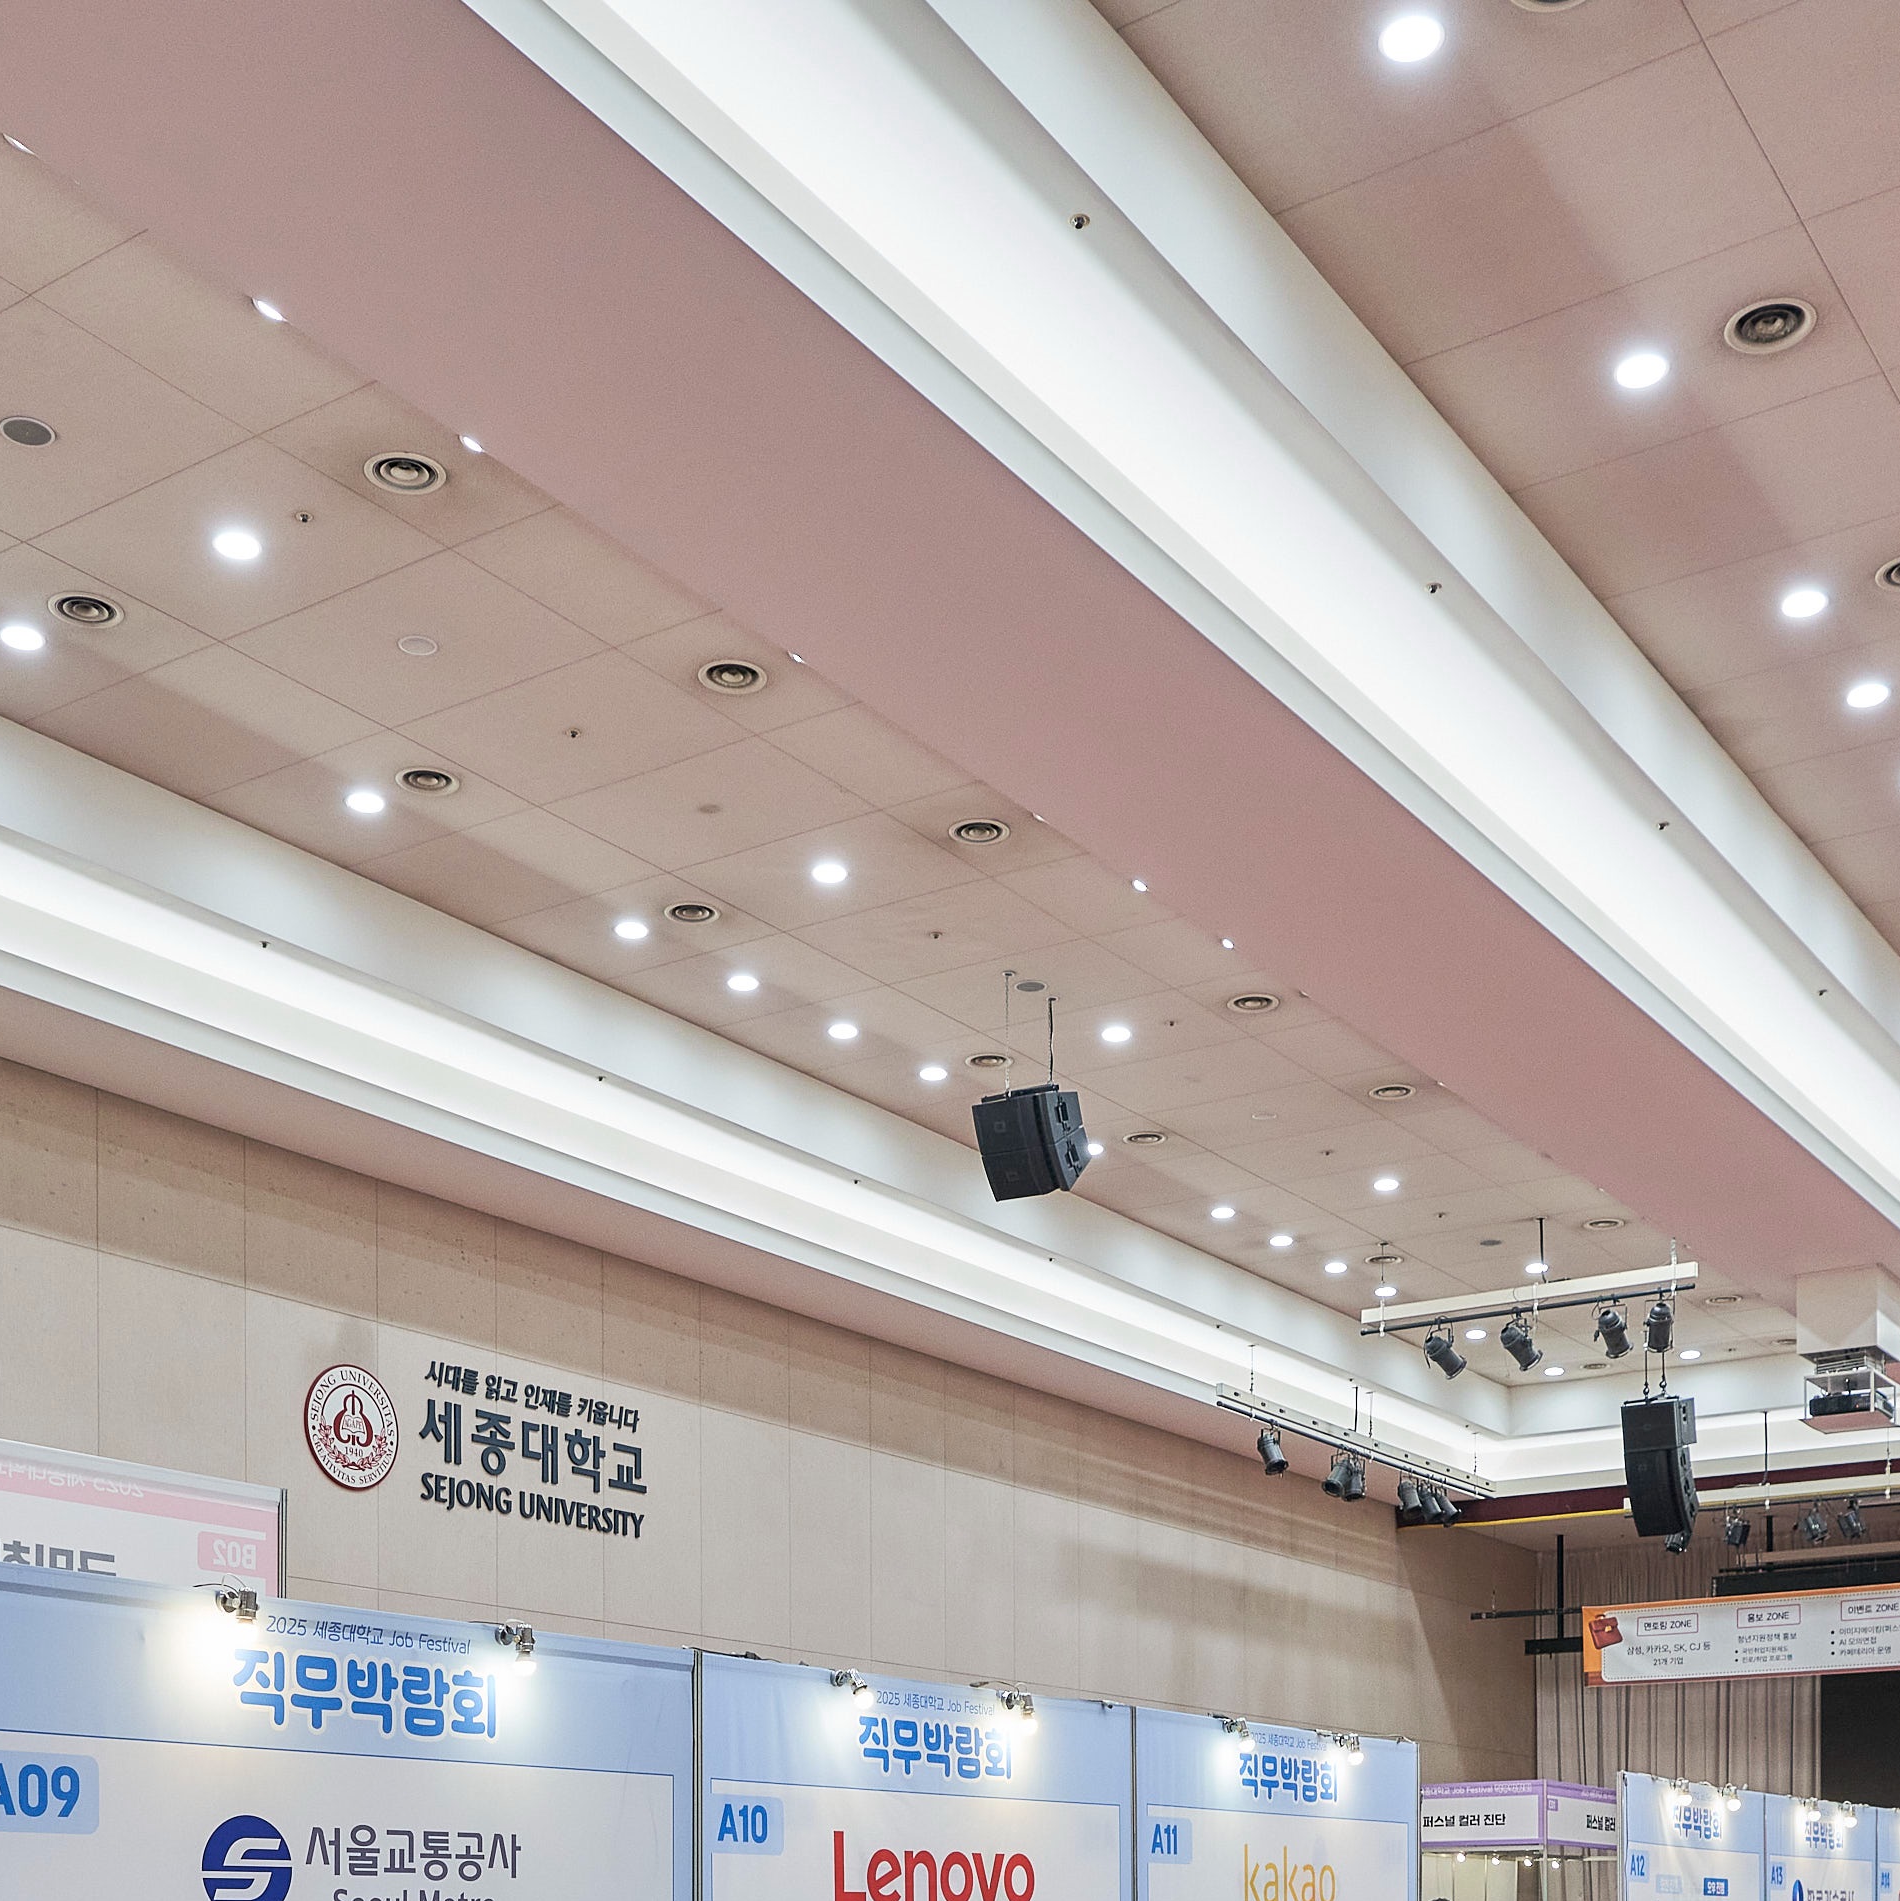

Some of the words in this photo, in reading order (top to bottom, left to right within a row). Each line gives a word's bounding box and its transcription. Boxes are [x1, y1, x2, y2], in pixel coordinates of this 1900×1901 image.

[310, 1374, 336, 1422] SEJONG
[340, 1370, 395, 1437] UNIVERSITAS
[424, 1361, 479, 1395] 시대를
[485, 1375, 518, 1403] 읽고
[524, 1384, 572, 1417] 인재를
[577, 1398, 640, 1433] 키웁니다
[311, 1433, 356, 1484] CREATIVITAS
[344, 1446, 364, 1458] 1940
[419, 1399, 647, 1494] 세종대학교
[420, 1472, 512, 1515] SEJONG
[519, 1491, 644, 1538] UNIVERSITY
[1670, 1619, 1692, 1629] ZONE
[1766, 1611, 1790, 1621] ZONE
[1848, 1604, 1873, 1615] 이벤트
[1876, 1602, 1899, 1612] ZONE
[266, 1615, 308, 1637] 2025
[312, 1619, 384, 1647] 세종대학교
[389, 1631, 414, 1650] Job
[418, 1632, 472, 1655] Festival
[1689, 1642, 1701, 1651] CJ
[231, 1647, 497, 1739] 직무박람회
[877, 1690, 900, 1706] 2025
[903, 1693, 944, 1711] 세종대학교
[947, 1700, 962, 1713] Job
[964, 1701, 996, 1716] Festival
[859, 1716, 1012, 1779] 직무박람회
[1239, 1753, 1338, 1802] 직무박람회
[717, 1803, 768, 1845] A10
[1151, 1823, 1179, 1855] A11
[1422, 1814, 1455, 1828] 퍼스널
[1459, 1814, 1480, 1828] 컬러
[1484, 1813, 1506, 1826] 진단
[304, 1824, 522, 1883] 서울교통공사
[1630, 1854, 1645, 1876] A12
[1771, 1866, 1783, 1885] A13
